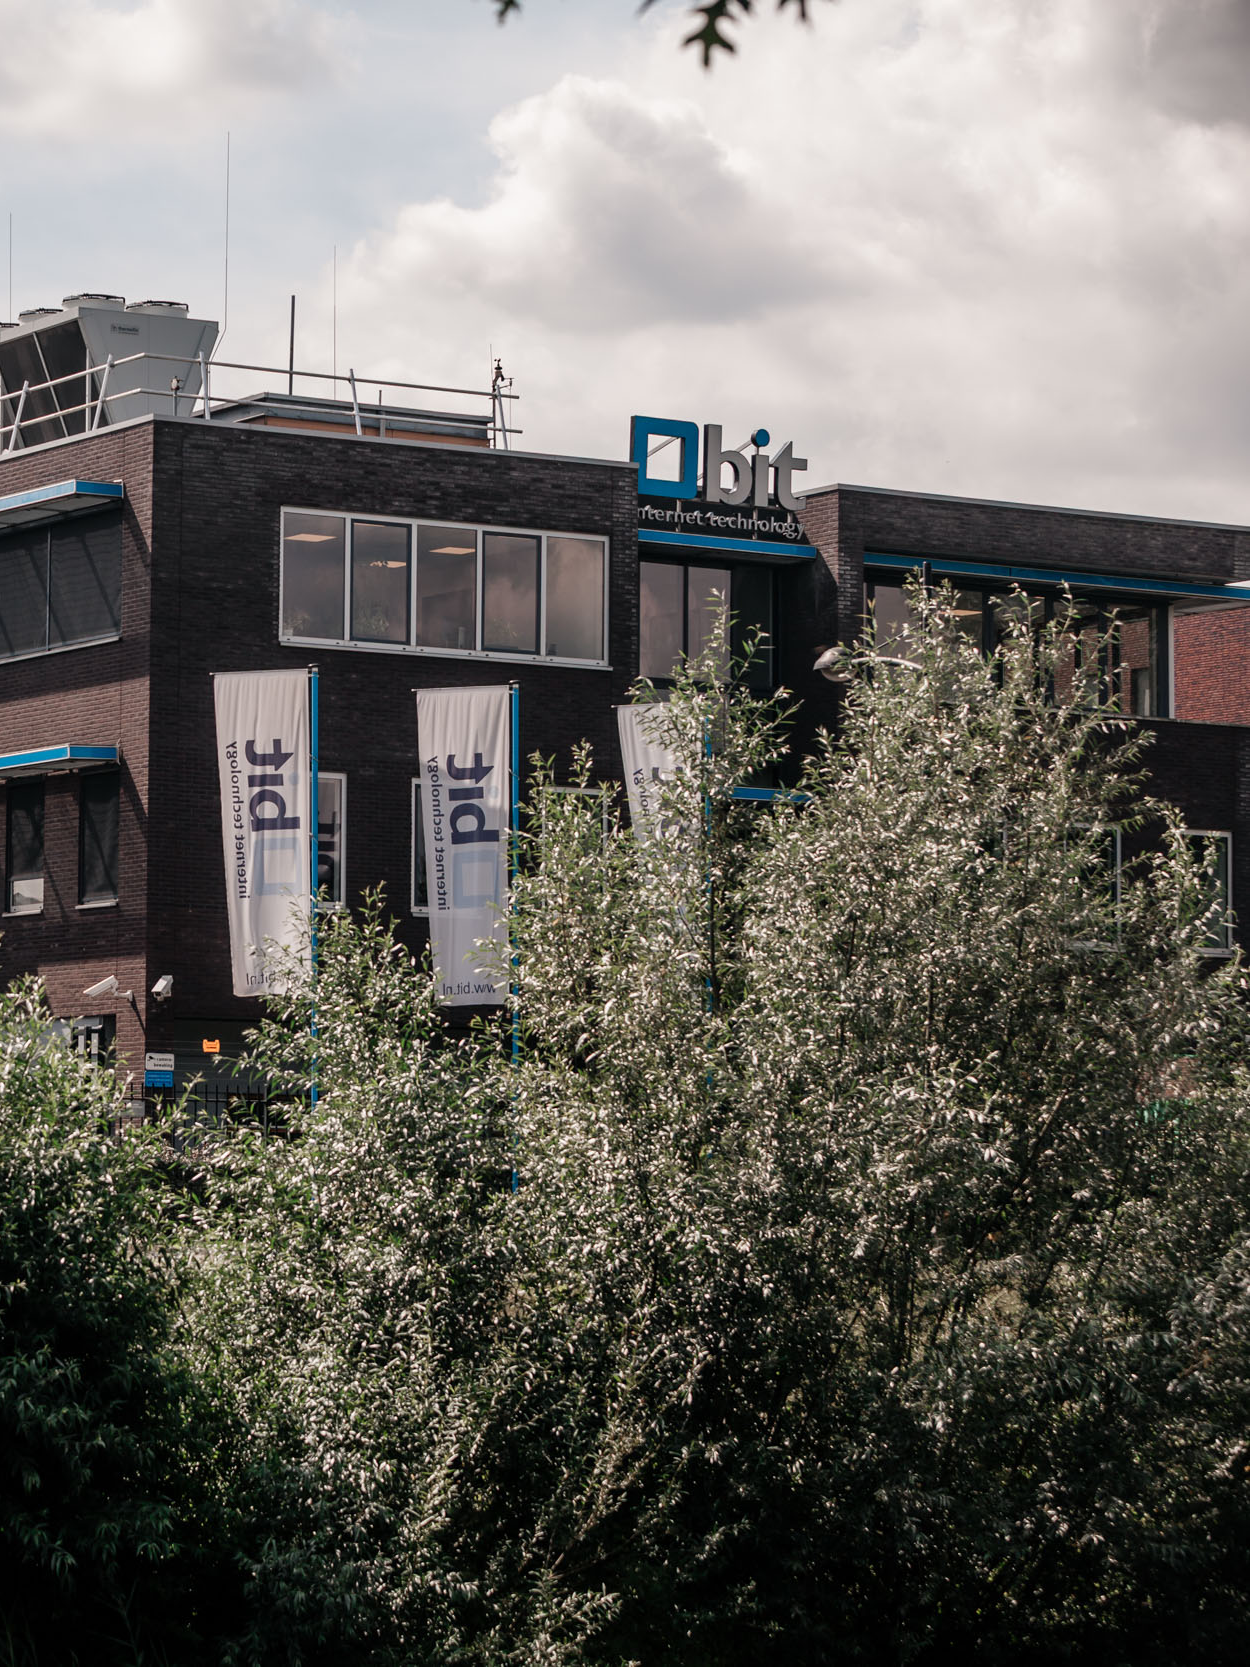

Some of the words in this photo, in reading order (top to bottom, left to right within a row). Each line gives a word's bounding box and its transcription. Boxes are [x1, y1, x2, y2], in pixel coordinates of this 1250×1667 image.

[703, 424, 808, 511] bit
[638, 504, 703, 526] nternet
[708, 511, 807, 540] technology
